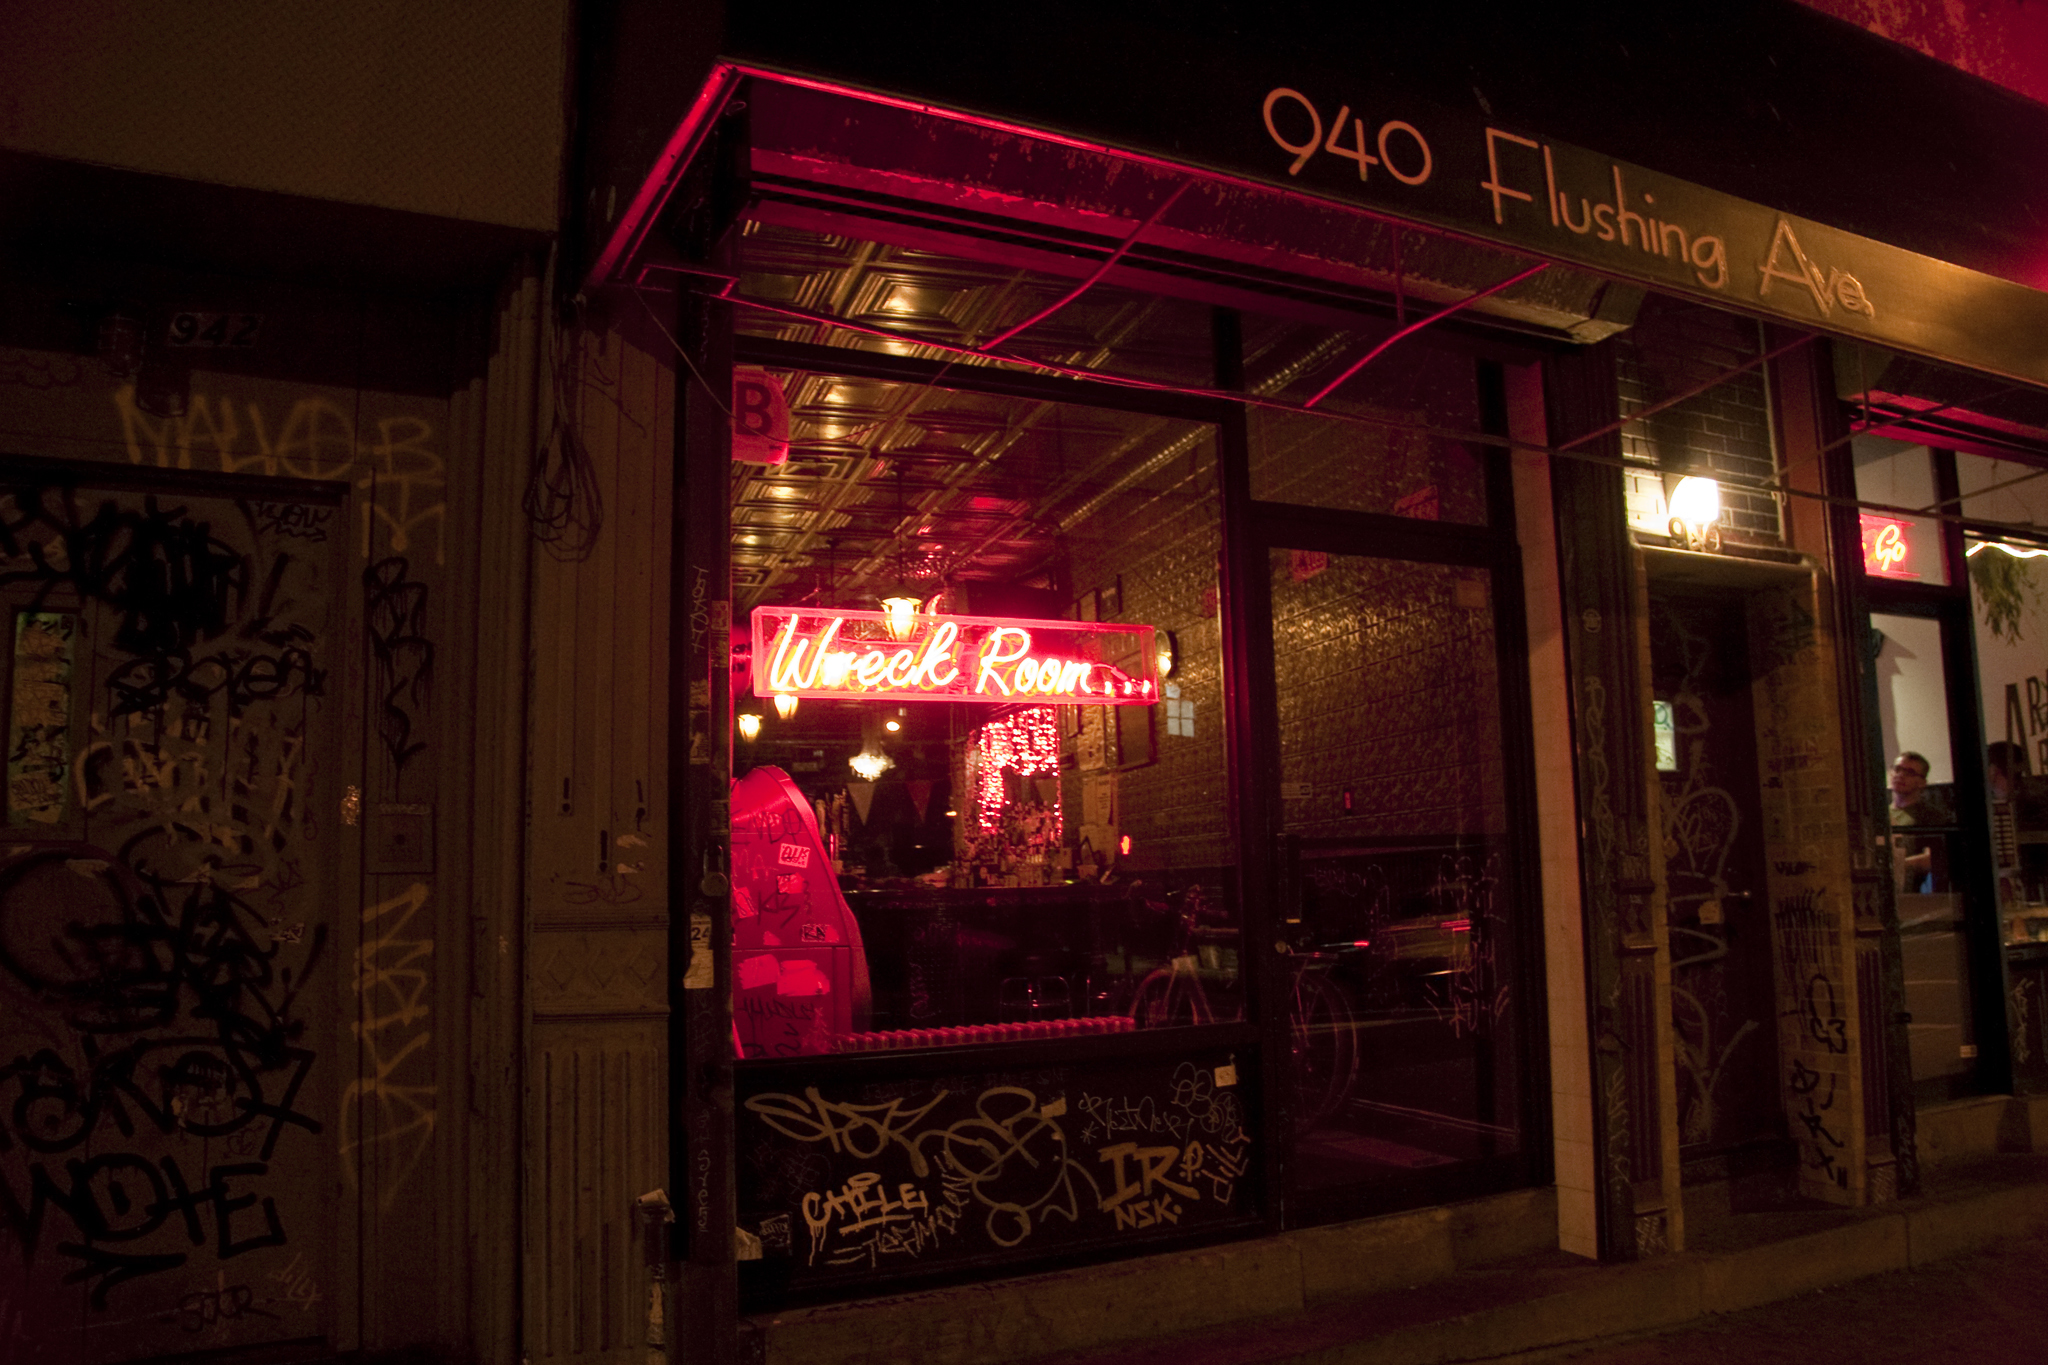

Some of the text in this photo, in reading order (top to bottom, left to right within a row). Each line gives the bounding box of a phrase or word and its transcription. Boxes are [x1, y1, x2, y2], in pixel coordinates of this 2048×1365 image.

[1263, 88, 1432, 186] 940
[1481, 127, 1728, 290] Flushing
[172, 313, 262, 346] 942
[770, 613, 959, 690] Wreck
